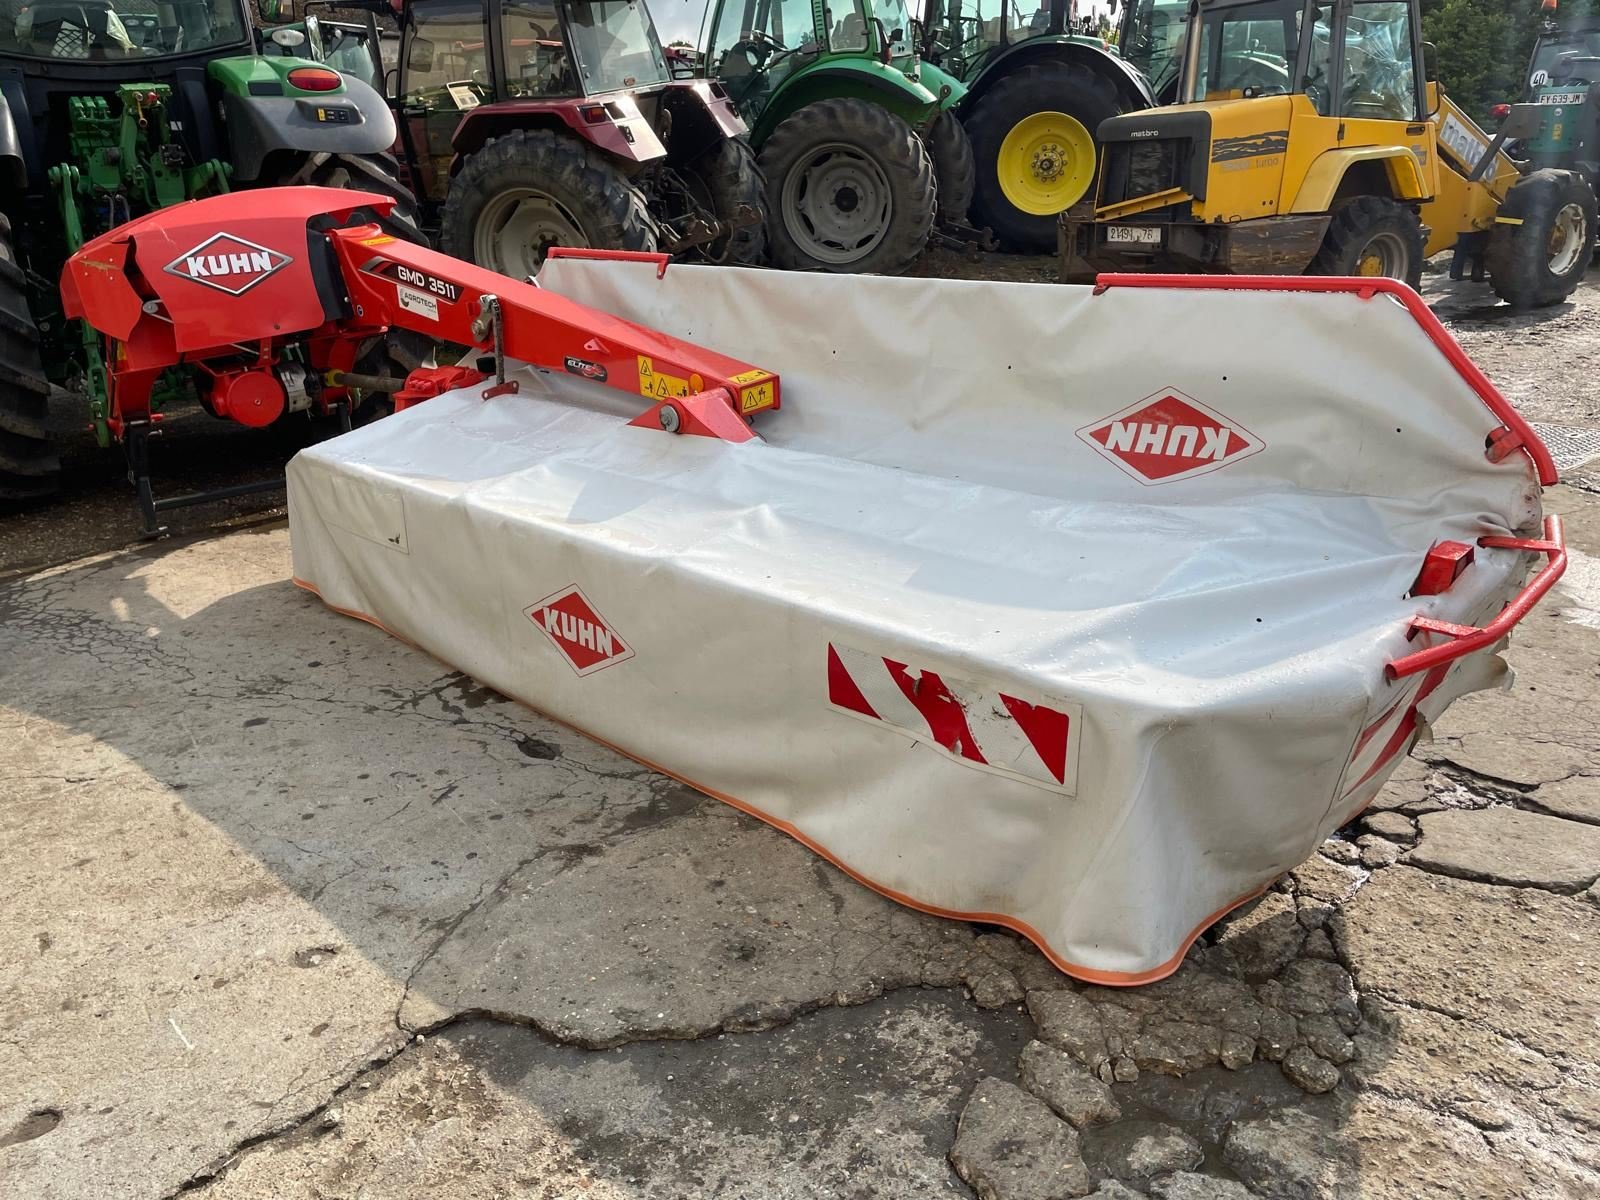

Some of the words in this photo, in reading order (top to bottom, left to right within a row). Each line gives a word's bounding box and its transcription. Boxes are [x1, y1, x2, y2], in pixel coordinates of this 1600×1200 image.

[1533, 73, 1545, 84] 40
[186, 251, 272, 277] KUHN
[397, 266, 425, 287] GMD
[428, 278, 456, 299] 3511
[404, 292, 437, 309] AGROTECH
[1104, 421, 1231, 461] KUHN
[542, 606, 613, 658] KUHN
